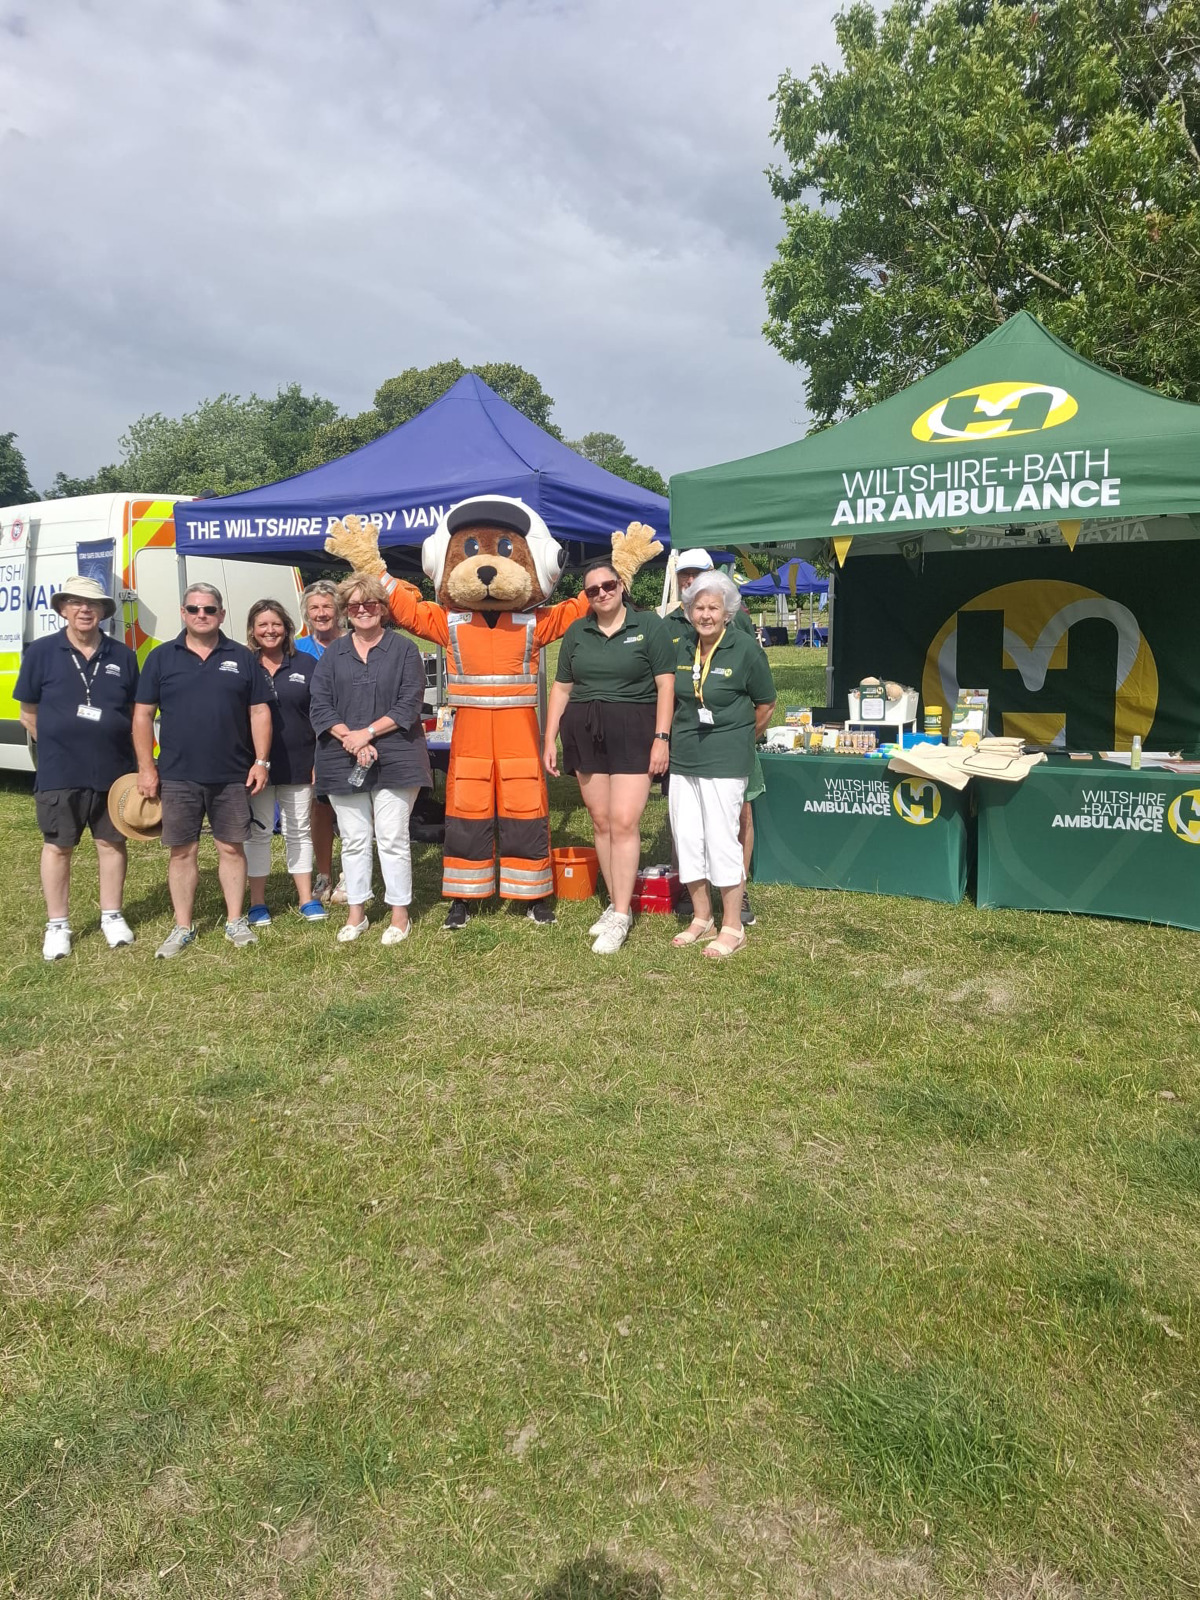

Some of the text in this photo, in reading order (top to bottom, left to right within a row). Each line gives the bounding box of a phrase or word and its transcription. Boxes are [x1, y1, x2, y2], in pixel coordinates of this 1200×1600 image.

[831, 478, 1121, 527] AIR AMBULANCE
[186, 520, 220, 540] THE
[224, 517, 323, 539] WILTSHIRE
[402, 505, 444, 529] VAN
[824, 778, 890, 793] WILTSHIRE
[825, 790, 890, 805] +BATH AIR
[1082, 789, 1167, 807] WILTSHIRE
[803, 800, 891, 816] AMBULANCE
[1081, 802, 1165, 820] +BATH AIR
[1051, 814, 1163, 833] AMBULANCE
